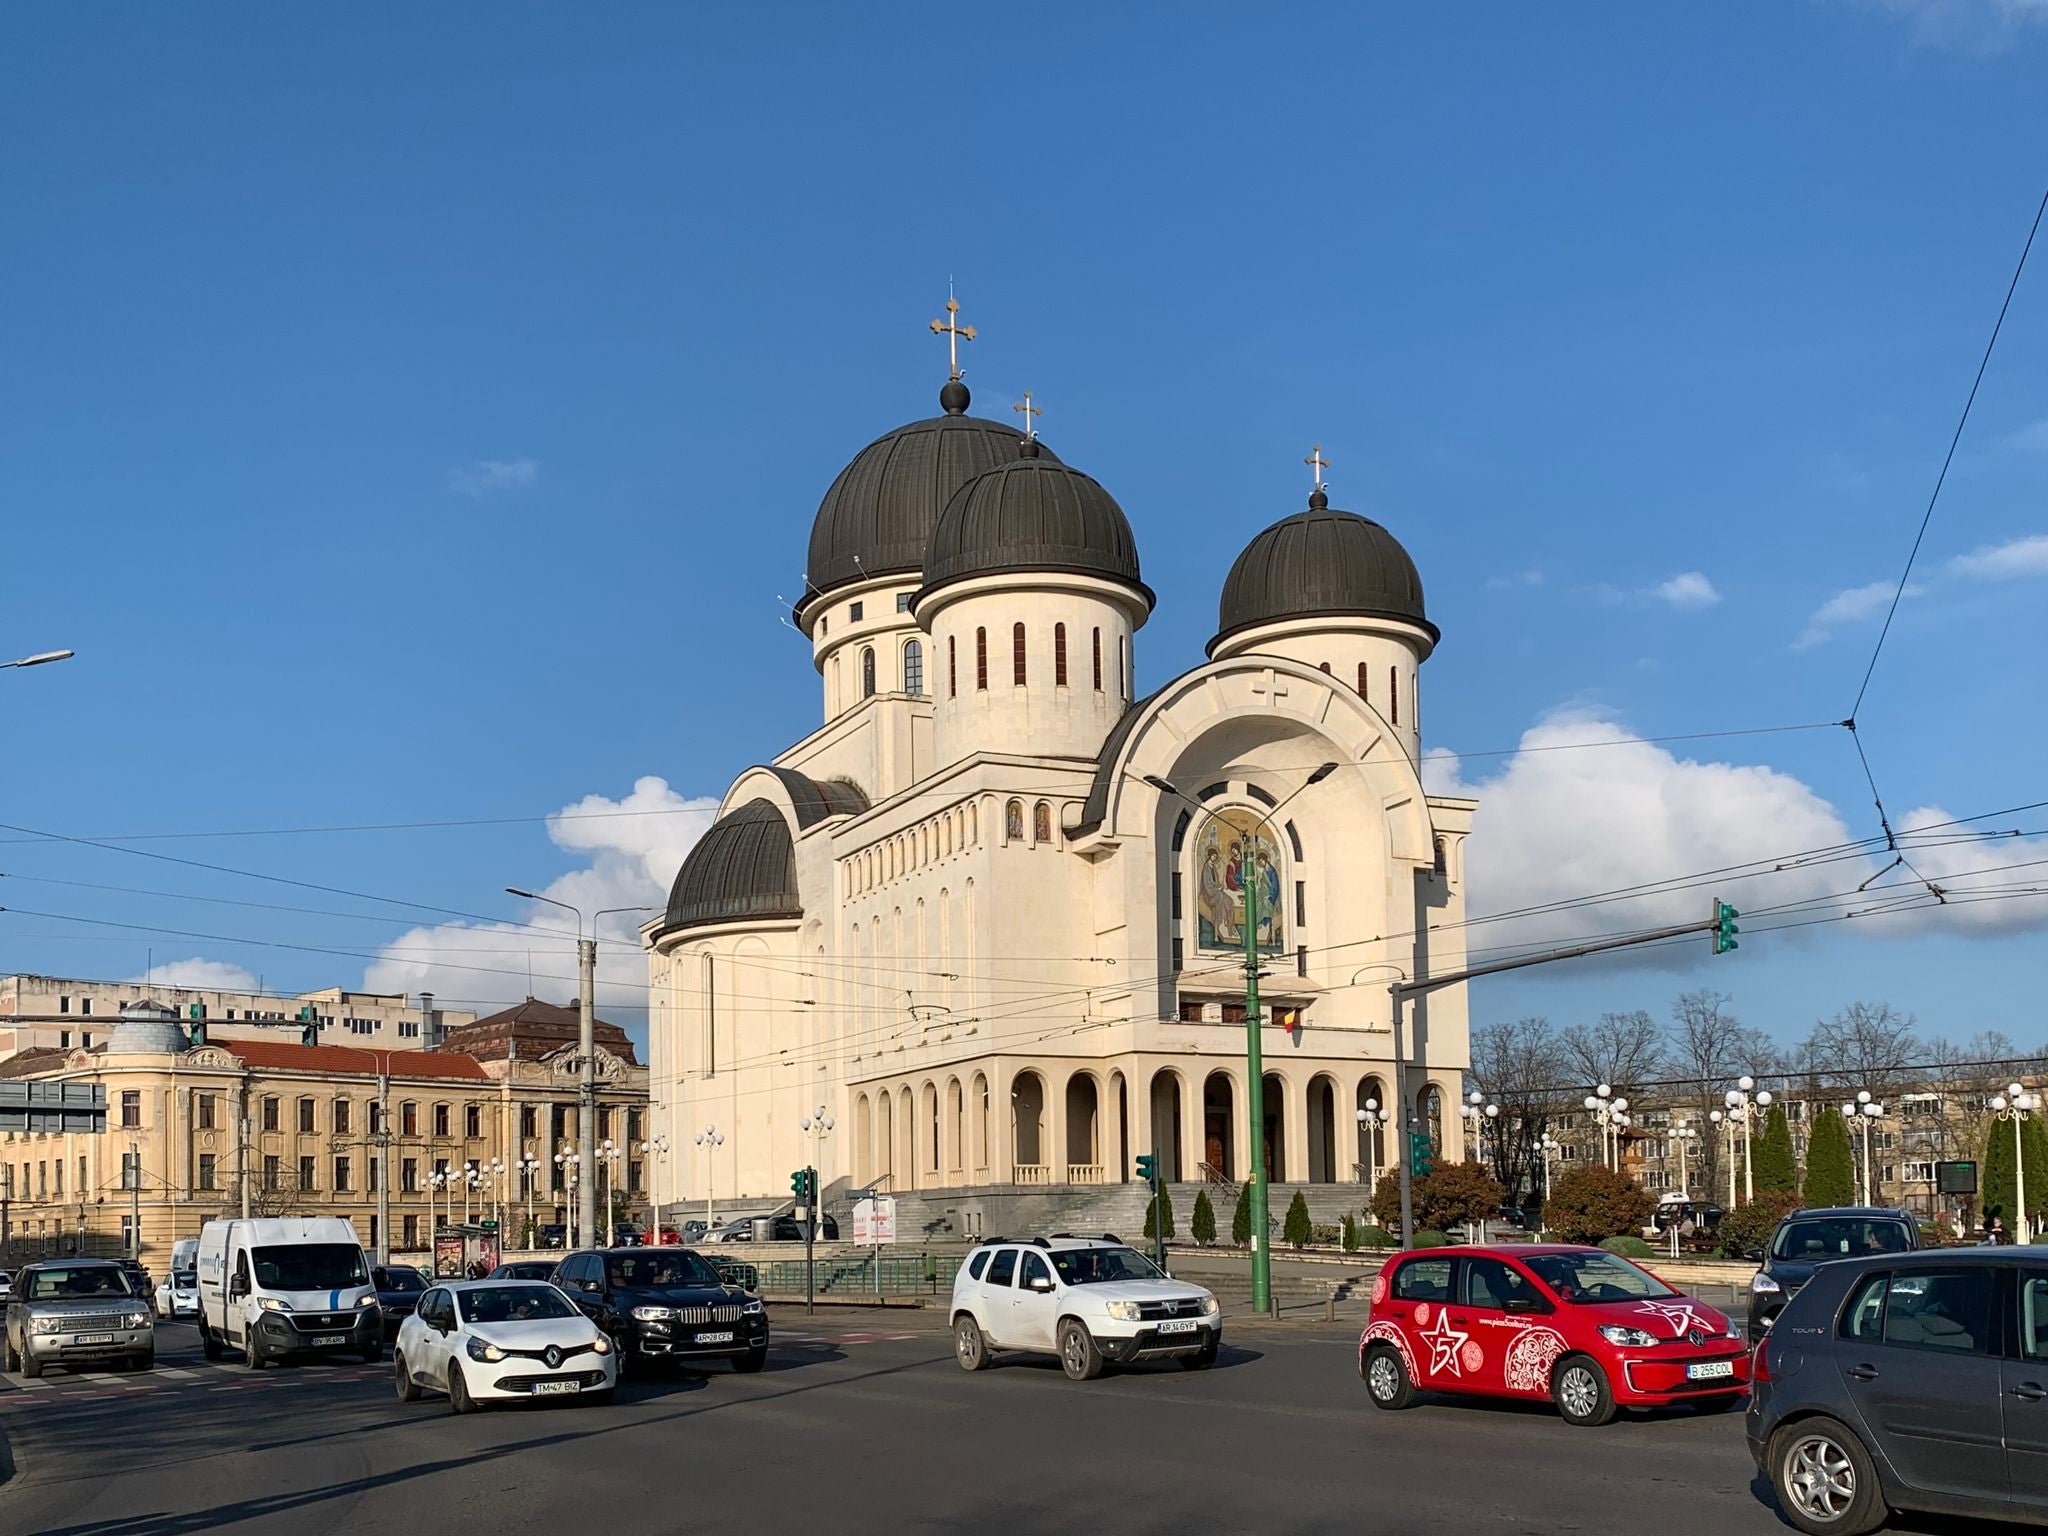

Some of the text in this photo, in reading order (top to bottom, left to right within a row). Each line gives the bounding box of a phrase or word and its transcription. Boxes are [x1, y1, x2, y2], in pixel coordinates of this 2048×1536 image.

[1162, 1323, 1171, 1331] AR
[718, 1332, 732, 1340] CFC
[1433, 1338, 1451, 1372] 5
[1691, 1363, 1731, 1377] B 255 COL
[538, 1384, 550, 1393] TM
[564, 1382, 578, 1391] BIZ
